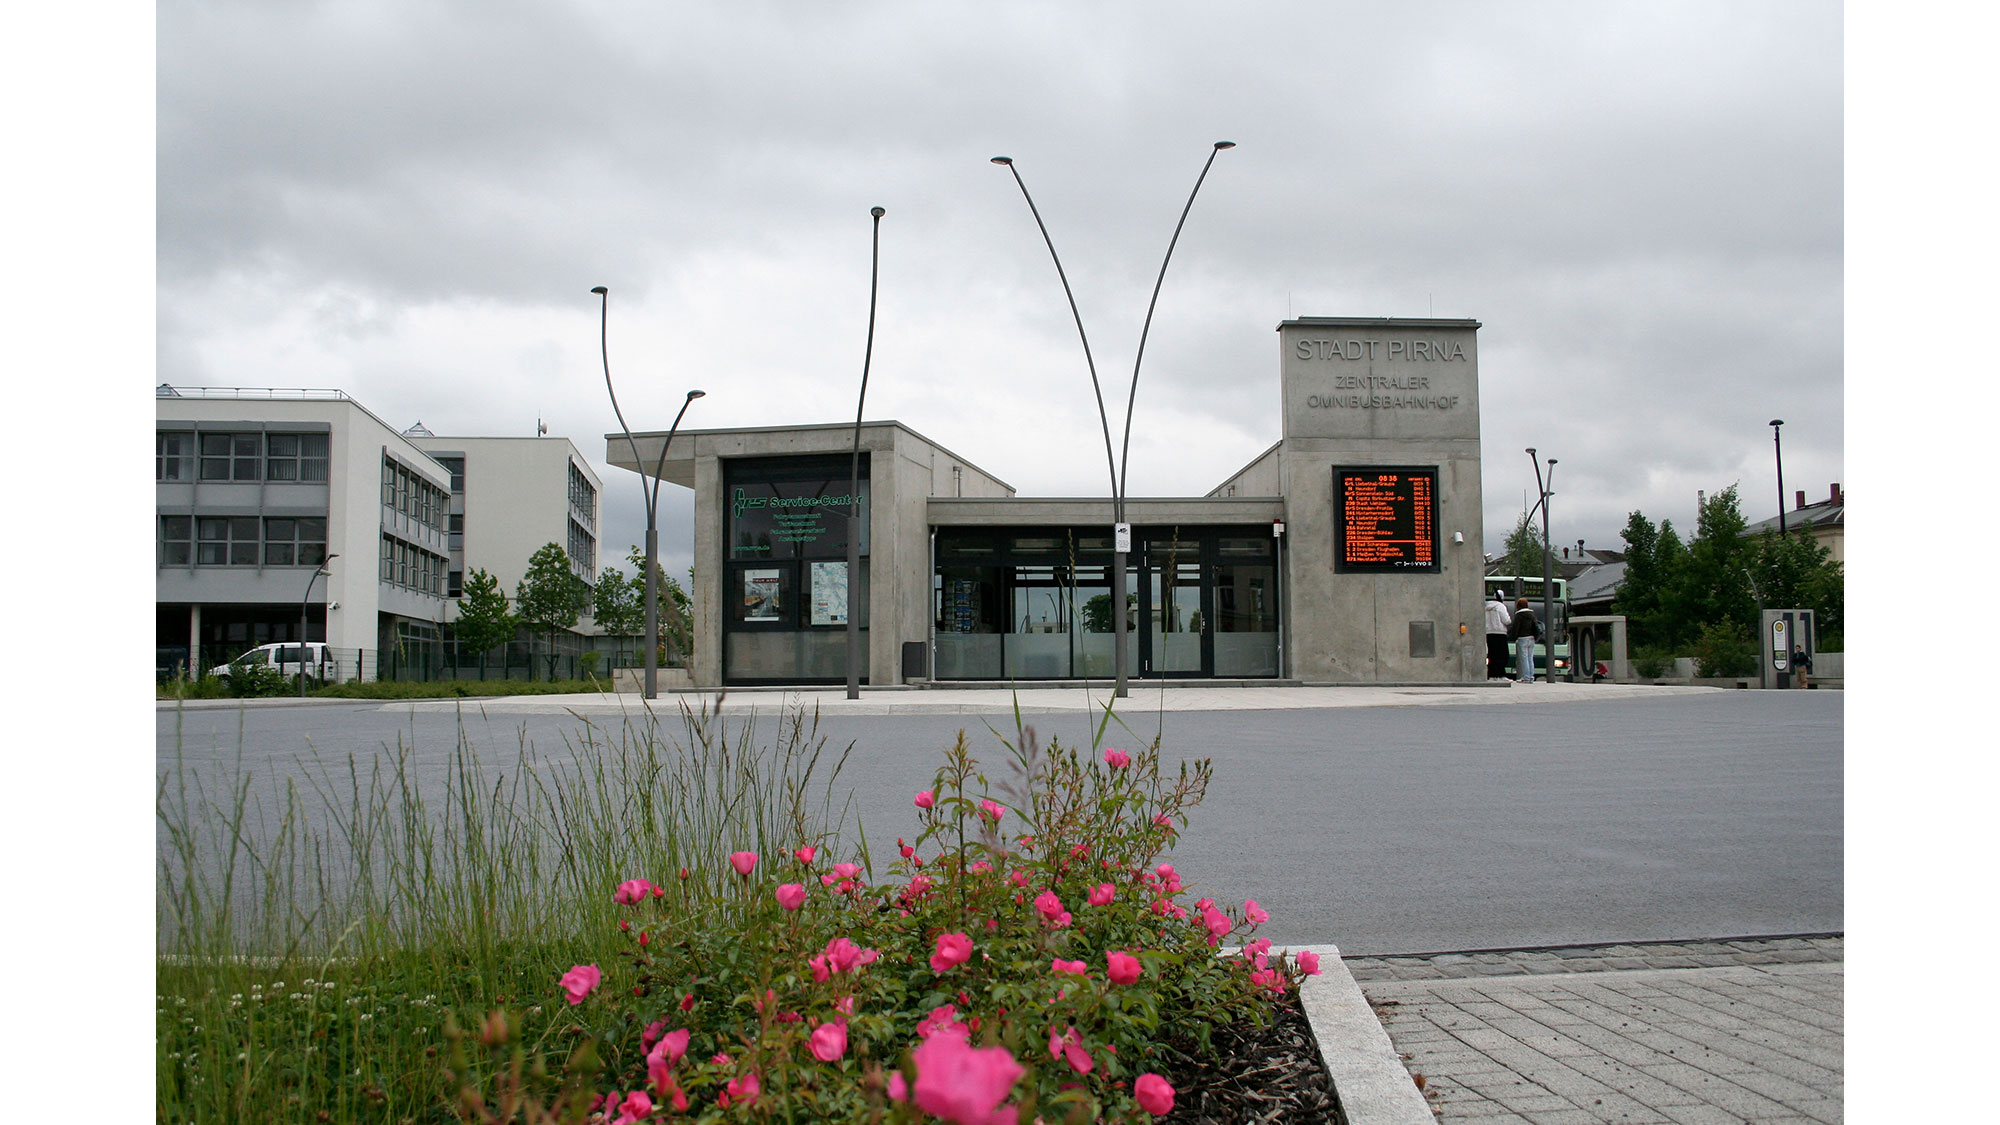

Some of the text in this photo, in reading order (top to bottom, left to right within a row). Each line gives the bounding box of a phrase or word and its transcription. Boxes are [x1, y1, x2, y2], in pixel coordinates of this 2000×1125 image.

[1296, 339, 1466, 362] STADT PIRNA
[1335, 375, 1430, 390] ZENTRALER
[1307, 395, 1459, 410] OMNIBUSBAHNHOF
[769, 494, 863, 508] Service-Centr
[1568, 626, 1596, 677] 10
[1783, 612, 1813, 675] 11
